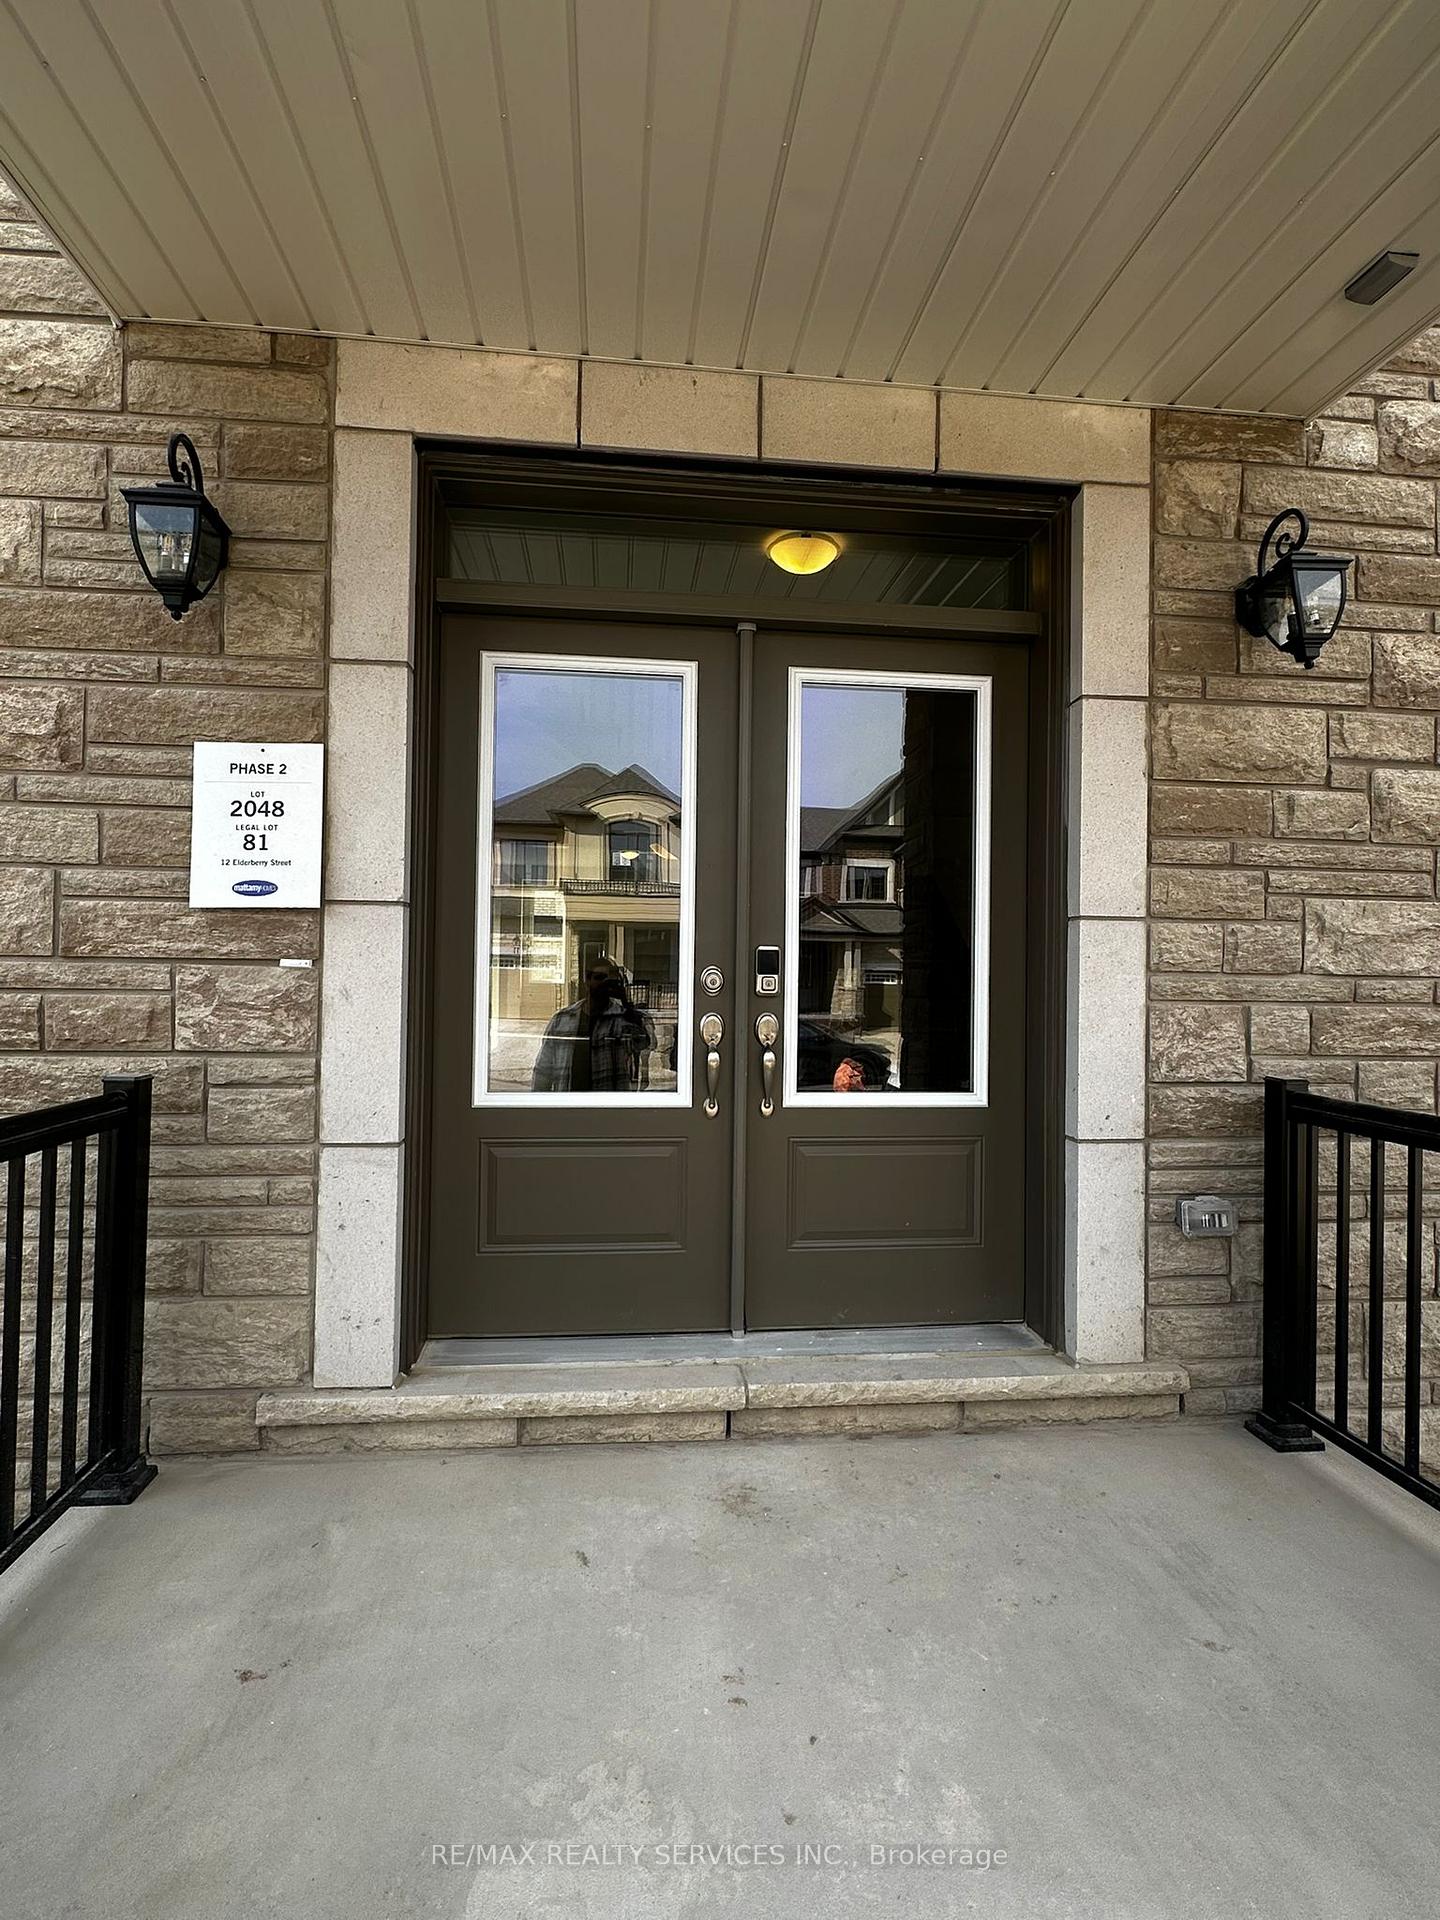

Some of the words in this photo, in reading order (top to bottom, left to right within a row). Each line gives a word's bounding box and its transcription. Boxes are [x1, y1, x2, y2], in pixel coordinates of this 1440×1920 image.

[229, 763, 275, 775] PHASE
[279, 763, 287, 775] 2
[230, 800, 285, 817] 2048
[242, 834, 268, 851] 81
[221, 858, 231, 866] 12
[233, 859, 268, 868] Elderberry
